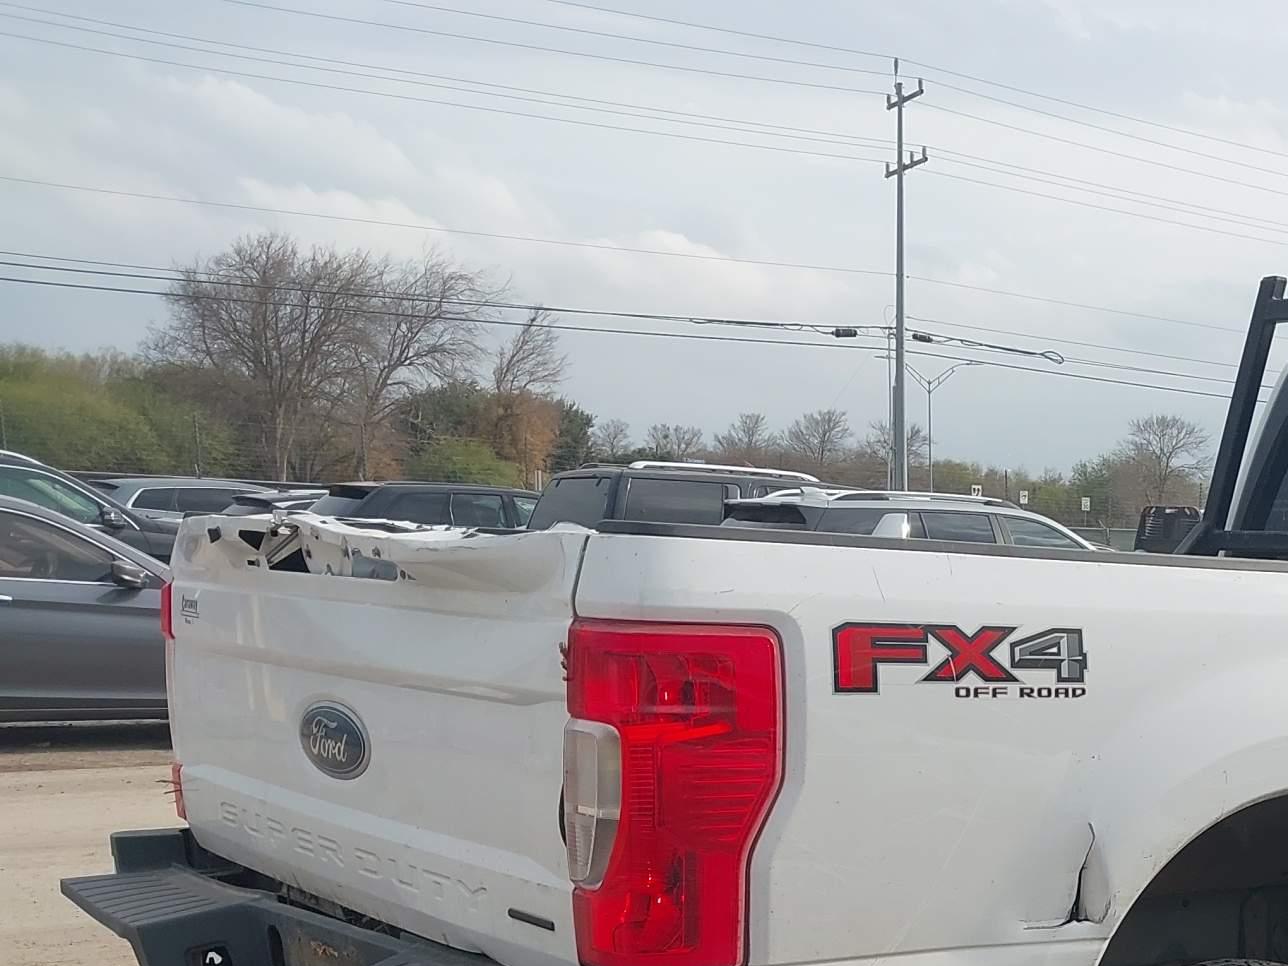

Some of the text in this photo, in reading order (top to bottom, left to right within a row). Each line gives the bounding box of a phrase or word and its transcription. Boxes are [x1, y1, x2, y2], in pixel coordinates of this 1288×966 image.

[831, 621, 1088, 694] FX4
[953, 686, 1087, 700] OFF ROAD
[310, 715, 349, 763] Ford
[219, 800, 489, 912] SUPER DUTY
